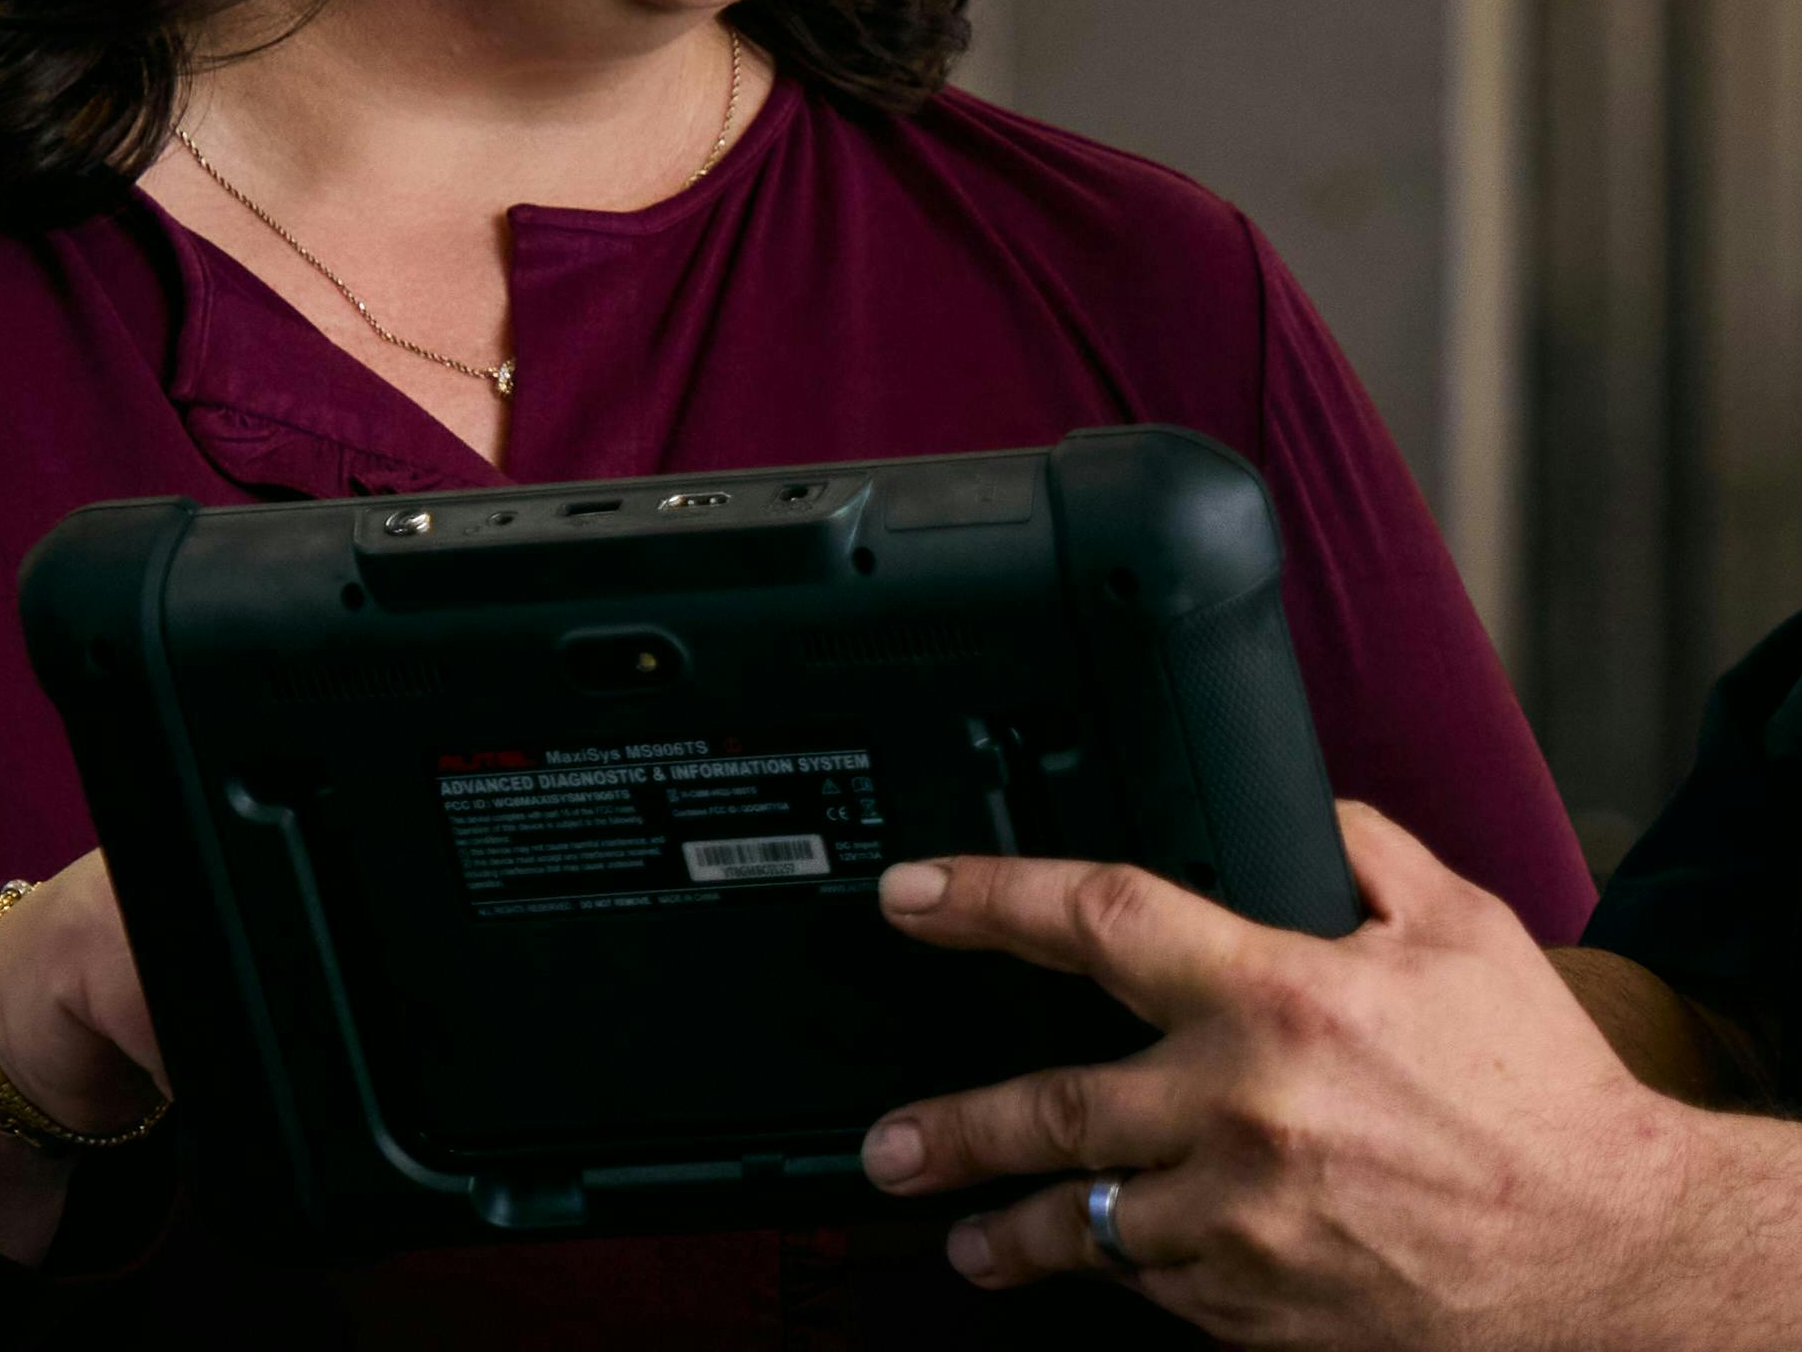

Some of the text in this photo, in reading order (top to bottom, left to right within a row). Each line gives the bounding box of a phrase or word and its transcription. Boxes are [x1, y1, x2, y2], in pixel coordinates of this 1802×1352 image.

[545, 747, 621, 765] MaxiSys
[625, 740, 710, 760] MS906TS
[440, 752, 871, 797] ADVANCED DIAGNOSTIC & INFORMATION SYSTEM
